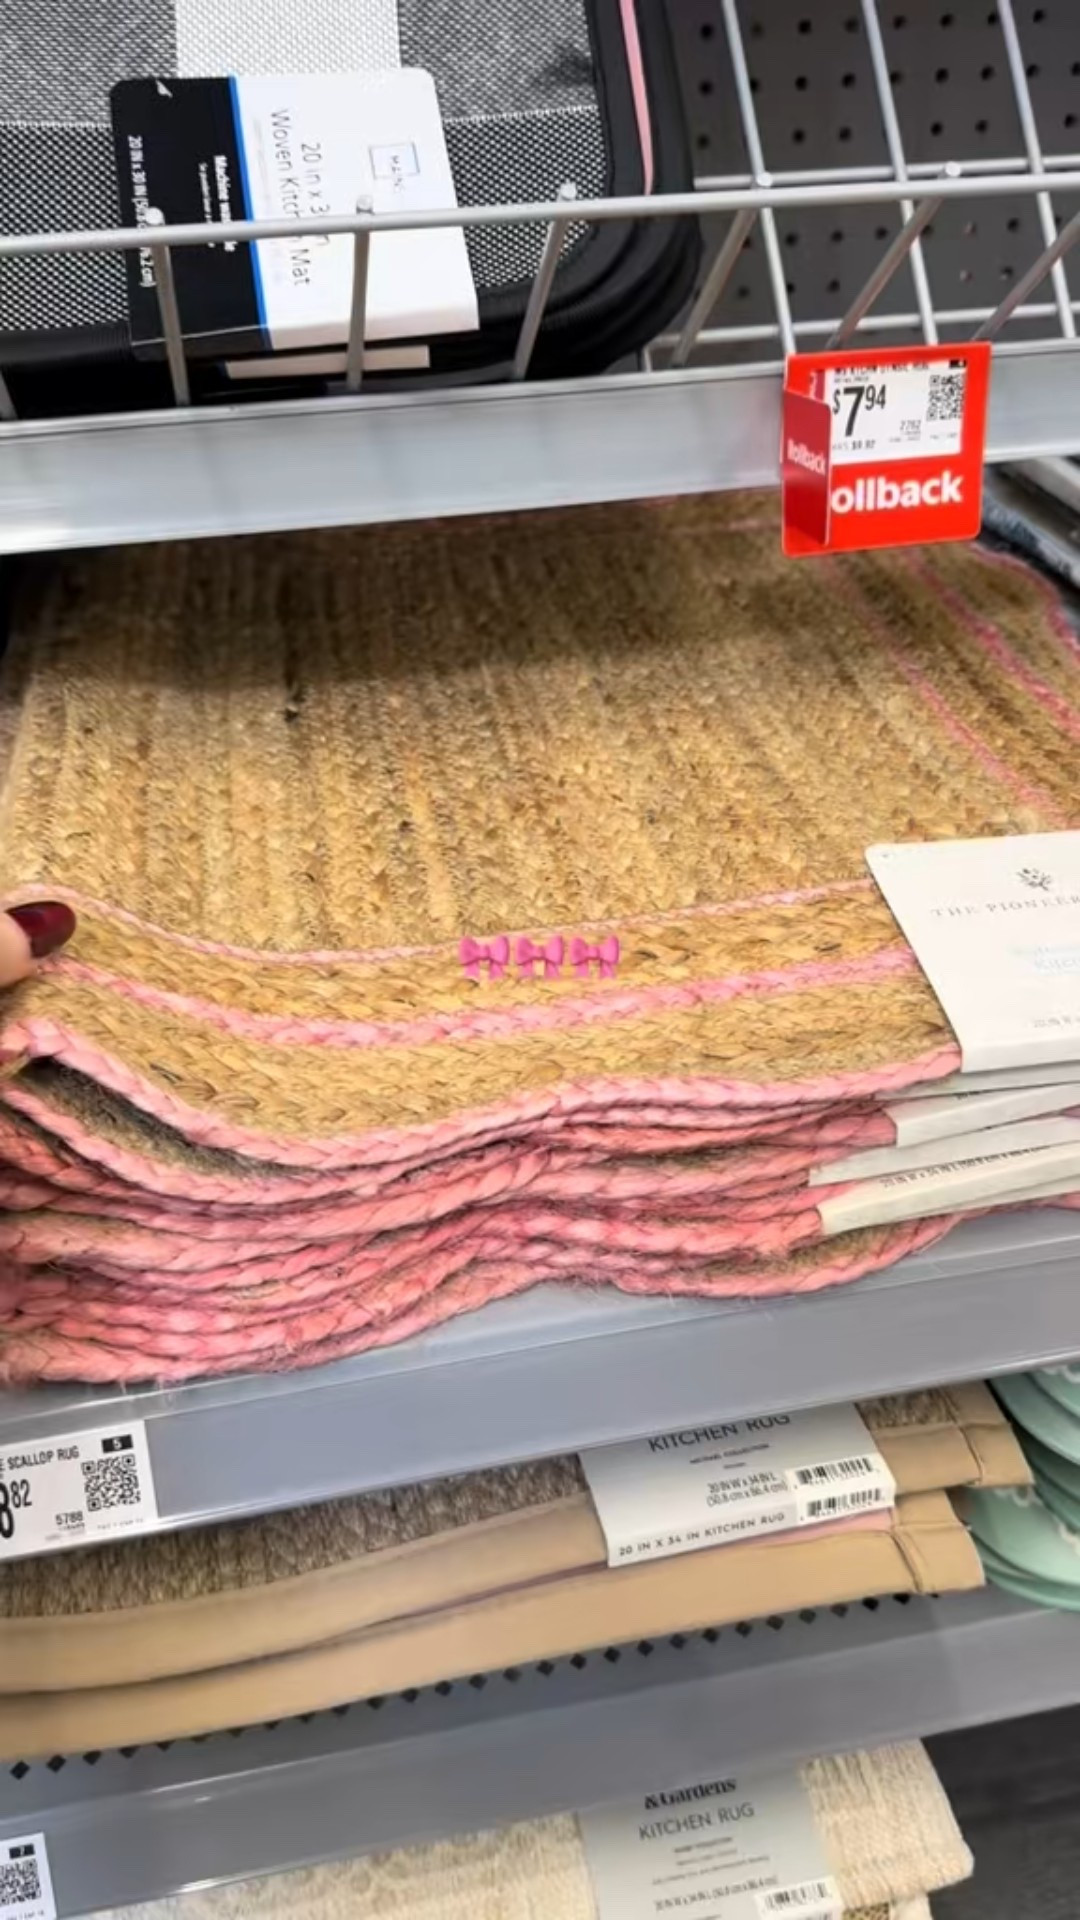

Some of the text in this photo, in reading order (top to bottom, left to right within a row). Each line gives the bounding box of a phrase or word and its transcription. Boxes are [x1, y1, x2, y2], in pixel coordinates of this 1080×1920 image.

[127, 134, 143, 149] 20
[301, 143, 322, 163] 20
[214, 155, 231, 200] Machine
[271, 108, 311, 286] Woven Kitchn Mat
[308, 191, 322, 199] x
[831, 470, 964, 514] ollback
[930, 905, 981, 917] THE
[648, 1422, 738, 1452] KITCHEN
[7, 1450, 54, 1471] SCALLOP
[57, 1445, 80, 1460] RUG
[618, 1512, 785, 1557] 20 IN X 34 IN KITCHEN RUG
[638, 1802, 754, 1841] KITCHEN RUG
